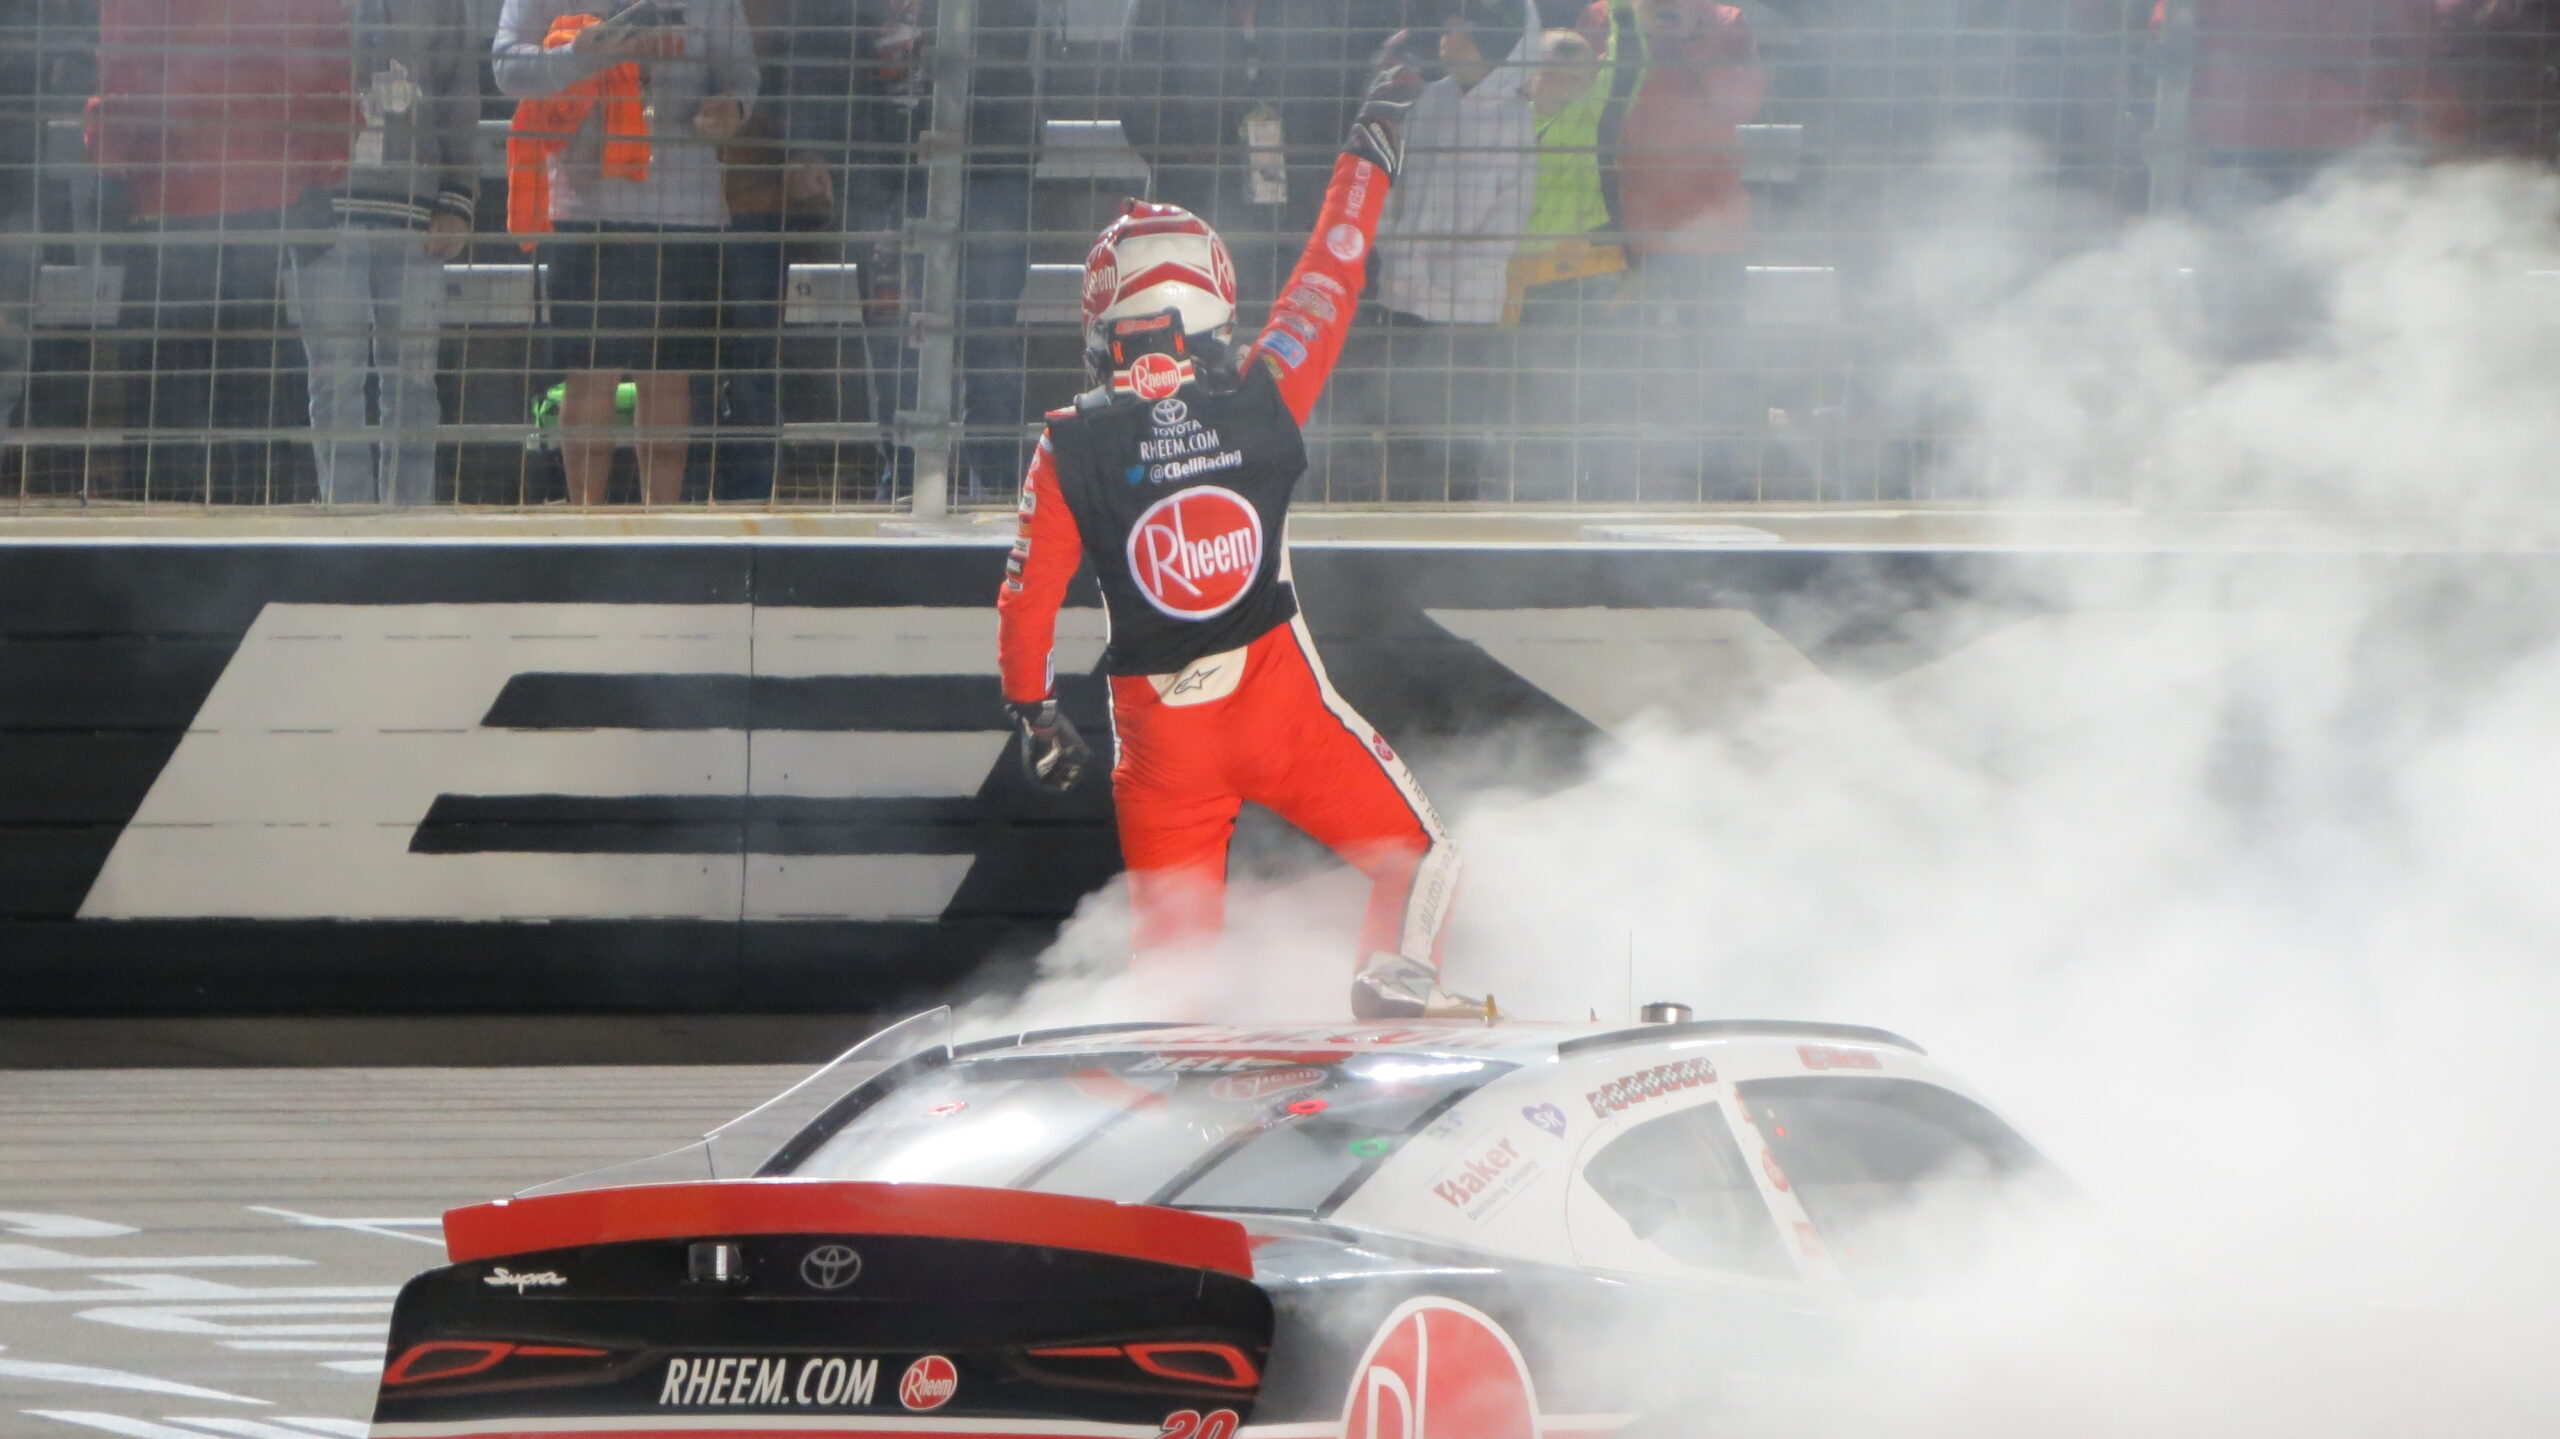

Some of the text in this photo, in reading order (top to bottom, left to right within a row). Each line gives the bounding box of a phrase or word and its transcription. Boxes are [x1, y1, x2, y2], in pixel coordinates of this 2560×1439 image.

[1134, 357, 1179, 393] Rheem
[1140, 429, 1220, 460] RHEEM.COM
[1152, 419, 1202, 437] TOYOTA
[1150, 449, 1243, 484] @CBellRacing
[1144, 502, 1254, 597] Rheem
[1533, 1110, 1565, 1129] SK
[483, 1267, 567, 1295] Supra
[659, 1357, 878, 1405] RHEEM.COM
[904, 1358, 953, 1403] Rheem
